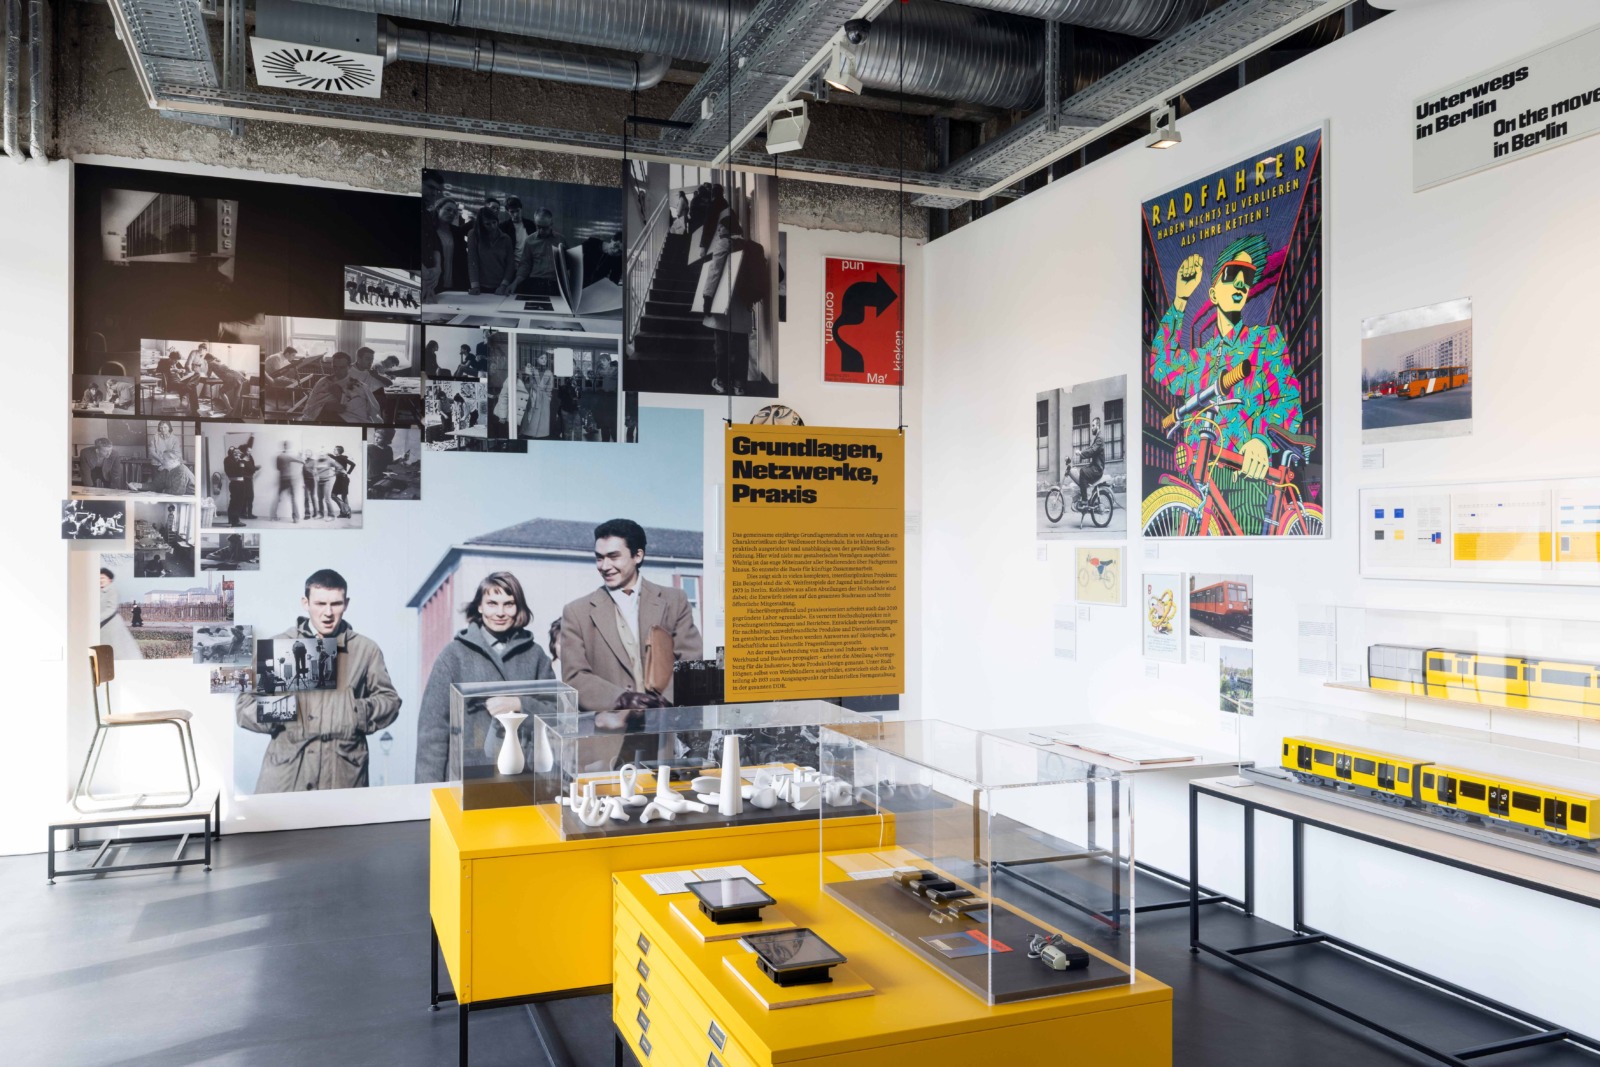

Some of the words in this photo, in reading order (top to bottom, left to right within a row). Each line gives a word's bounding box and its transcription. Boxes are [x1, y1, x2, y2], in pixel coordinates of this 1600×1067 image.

[1416, 66, 1529, 120] Unterwegs
[1416, 122, 1433, 140] in
[1435, 99, 1497, 134] Berlin
[1493, 117, 1516, 137] On
[1518, 106, 1549, 129] the
[1493, 141, 1509, 159] in
[1511, 120, 1568, 153] Berlin
[1152, 145, 1307, 227] RADFAHRER
[1157, 221, 1185, 241] HABEN
[1188, 206, 1222, 229] NICHTS
[1225, 200, 1238, 216] ZU
[1241, 178, 1300, 208] VERLIEREN
[1181, 233, 1196, 248] ALS
[1199, 223, 1222, 240] IHRE
[732, 436, 883, 462] Grundlagen,
[732, 460, 879, 485] Netzwerke,
[732, 483, 817, 503] Praxis
[780, 647, 809, 655] Verbindung
